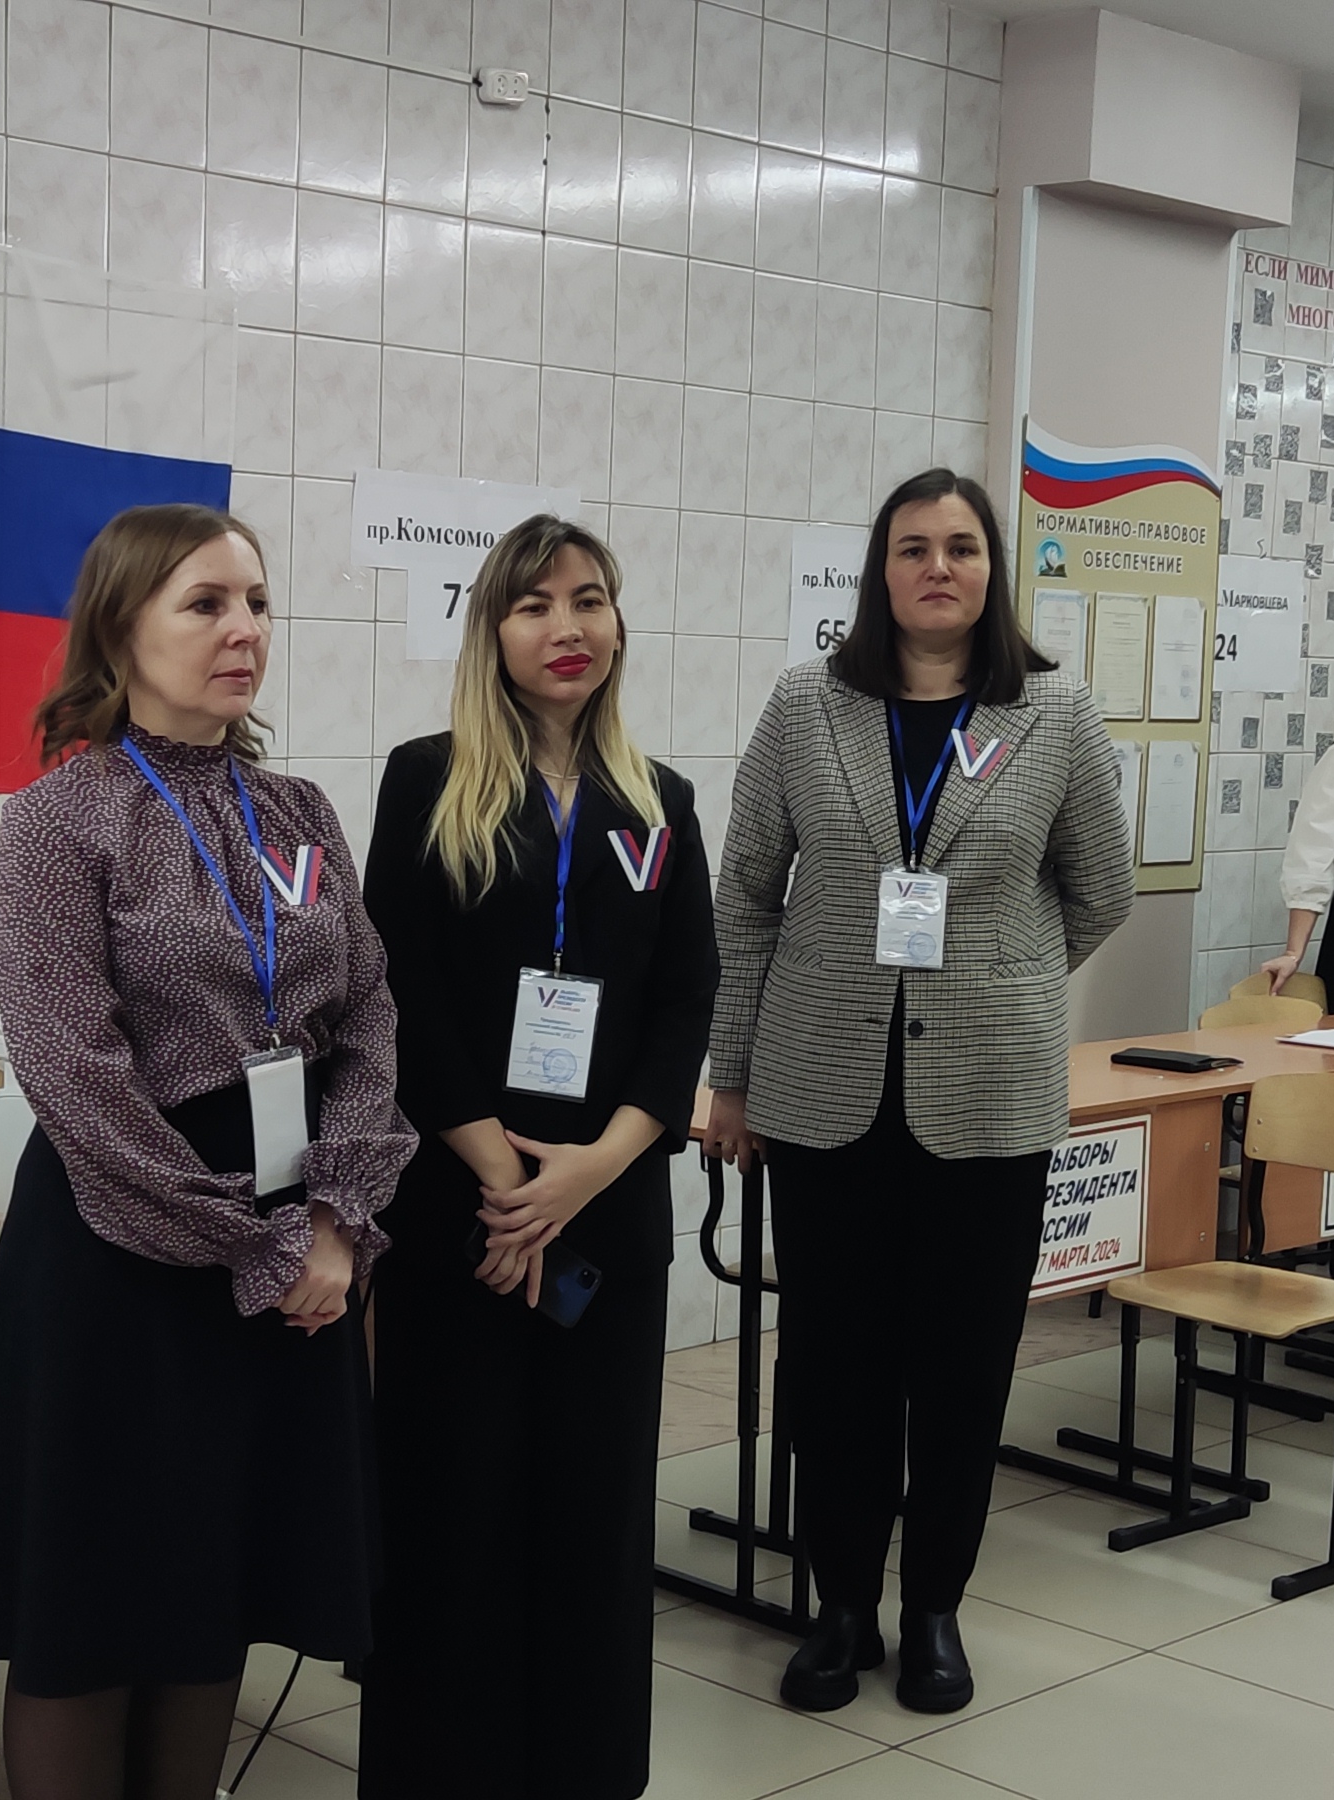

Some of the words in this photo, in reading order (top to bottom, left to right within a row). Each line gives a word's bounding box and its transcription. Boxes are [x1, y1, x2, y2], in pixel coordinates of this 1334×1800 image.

[1244, 252, 1289, 281] ЕСЛИ
[366, 516, 505, 549] пр.Комсомо
[1036, 513, 1207, 546] НОРМАТИВНО-ПРАВОВОЕ
[1083, 551, 1183, 574] ОБЕСПЕЧЕНИЕ
[1214, 633, 1237, 661] 24
[1050, 1139, 1118, 1173] ЫБОРЫ
[1045, 1169, 1138, 1208] РЕЗИДЕНТА
[1043, 1211, 1091, 1243] ССИИ
[1048, 1244, 1090, 1273] МАРТА
[1091, 1237, 1120, 1264] 2024
